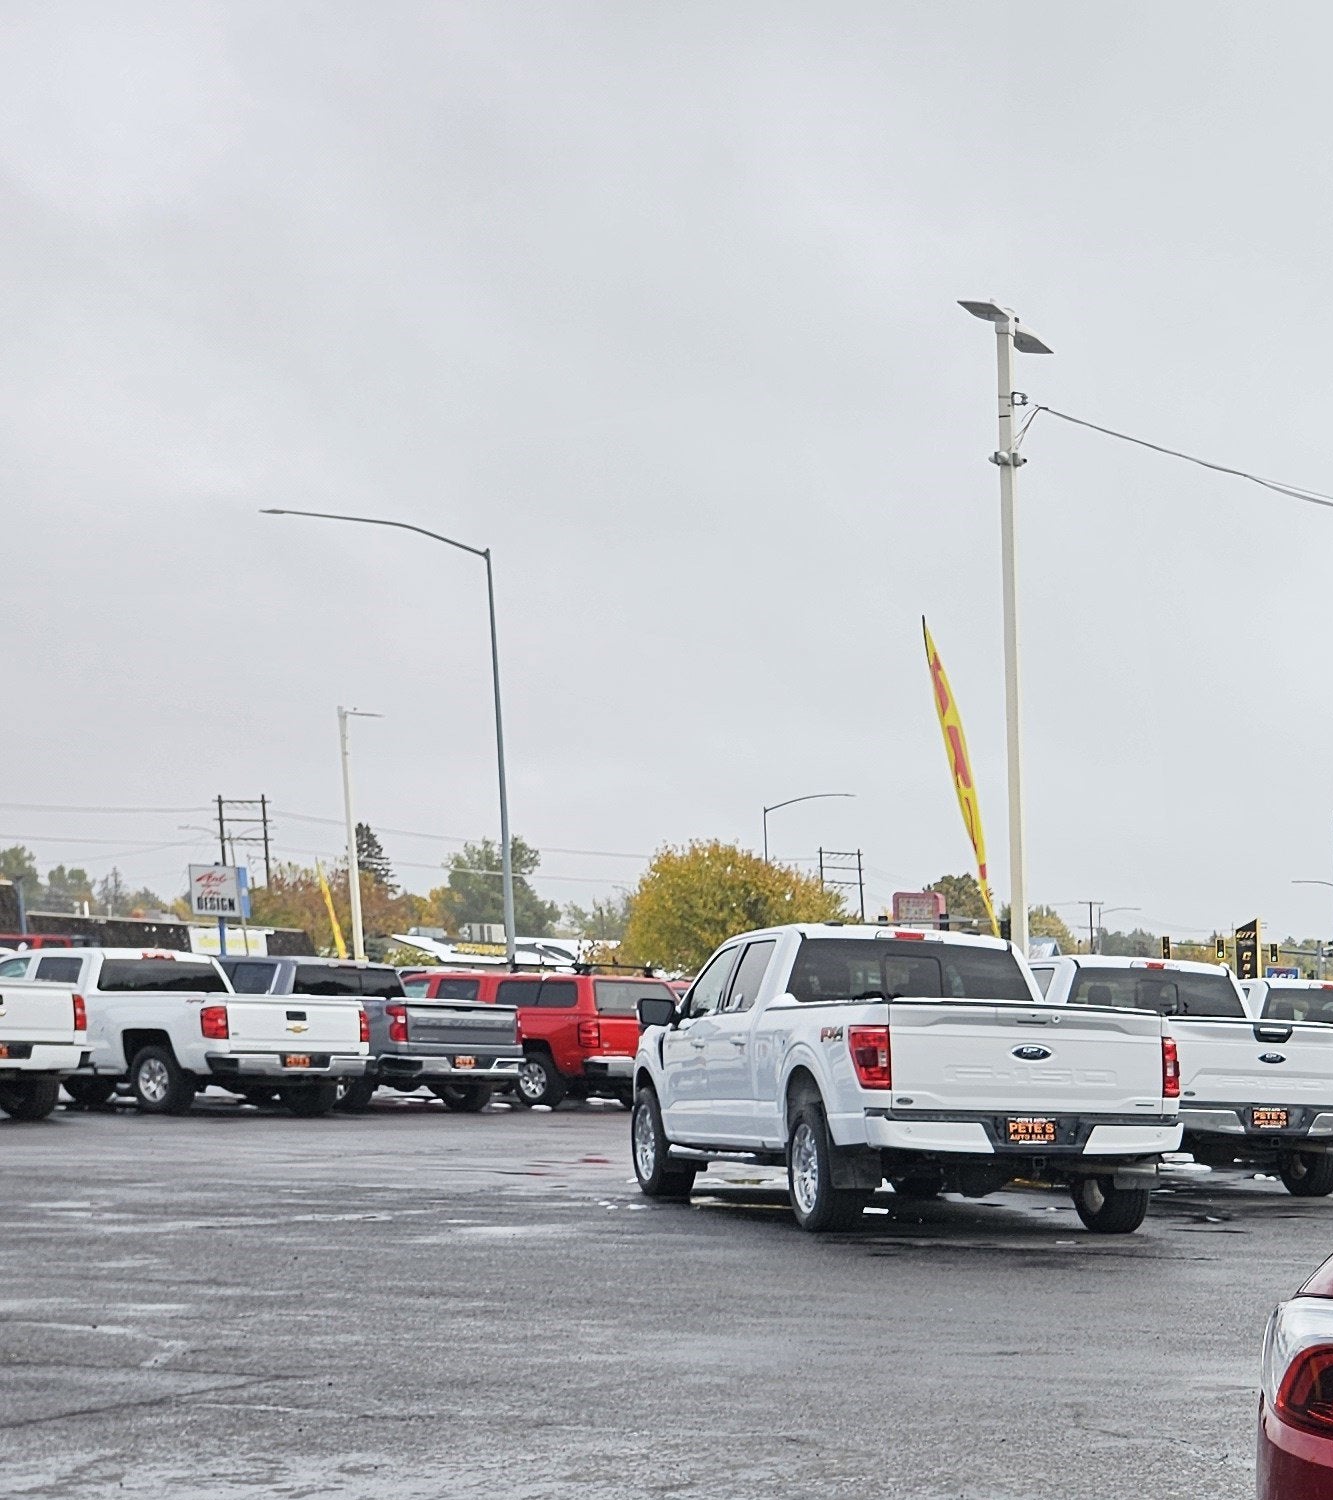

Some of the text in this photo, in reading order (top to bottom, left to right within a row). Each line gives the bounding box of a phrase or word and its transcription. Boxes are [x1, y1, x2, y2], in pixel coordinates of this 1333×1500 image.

[944, 1064, 1118, 1087] F-150
[1253, 1111, 1287, 1120] PETE'S
[1009, 1122, 1054, 1133] PETE'S
